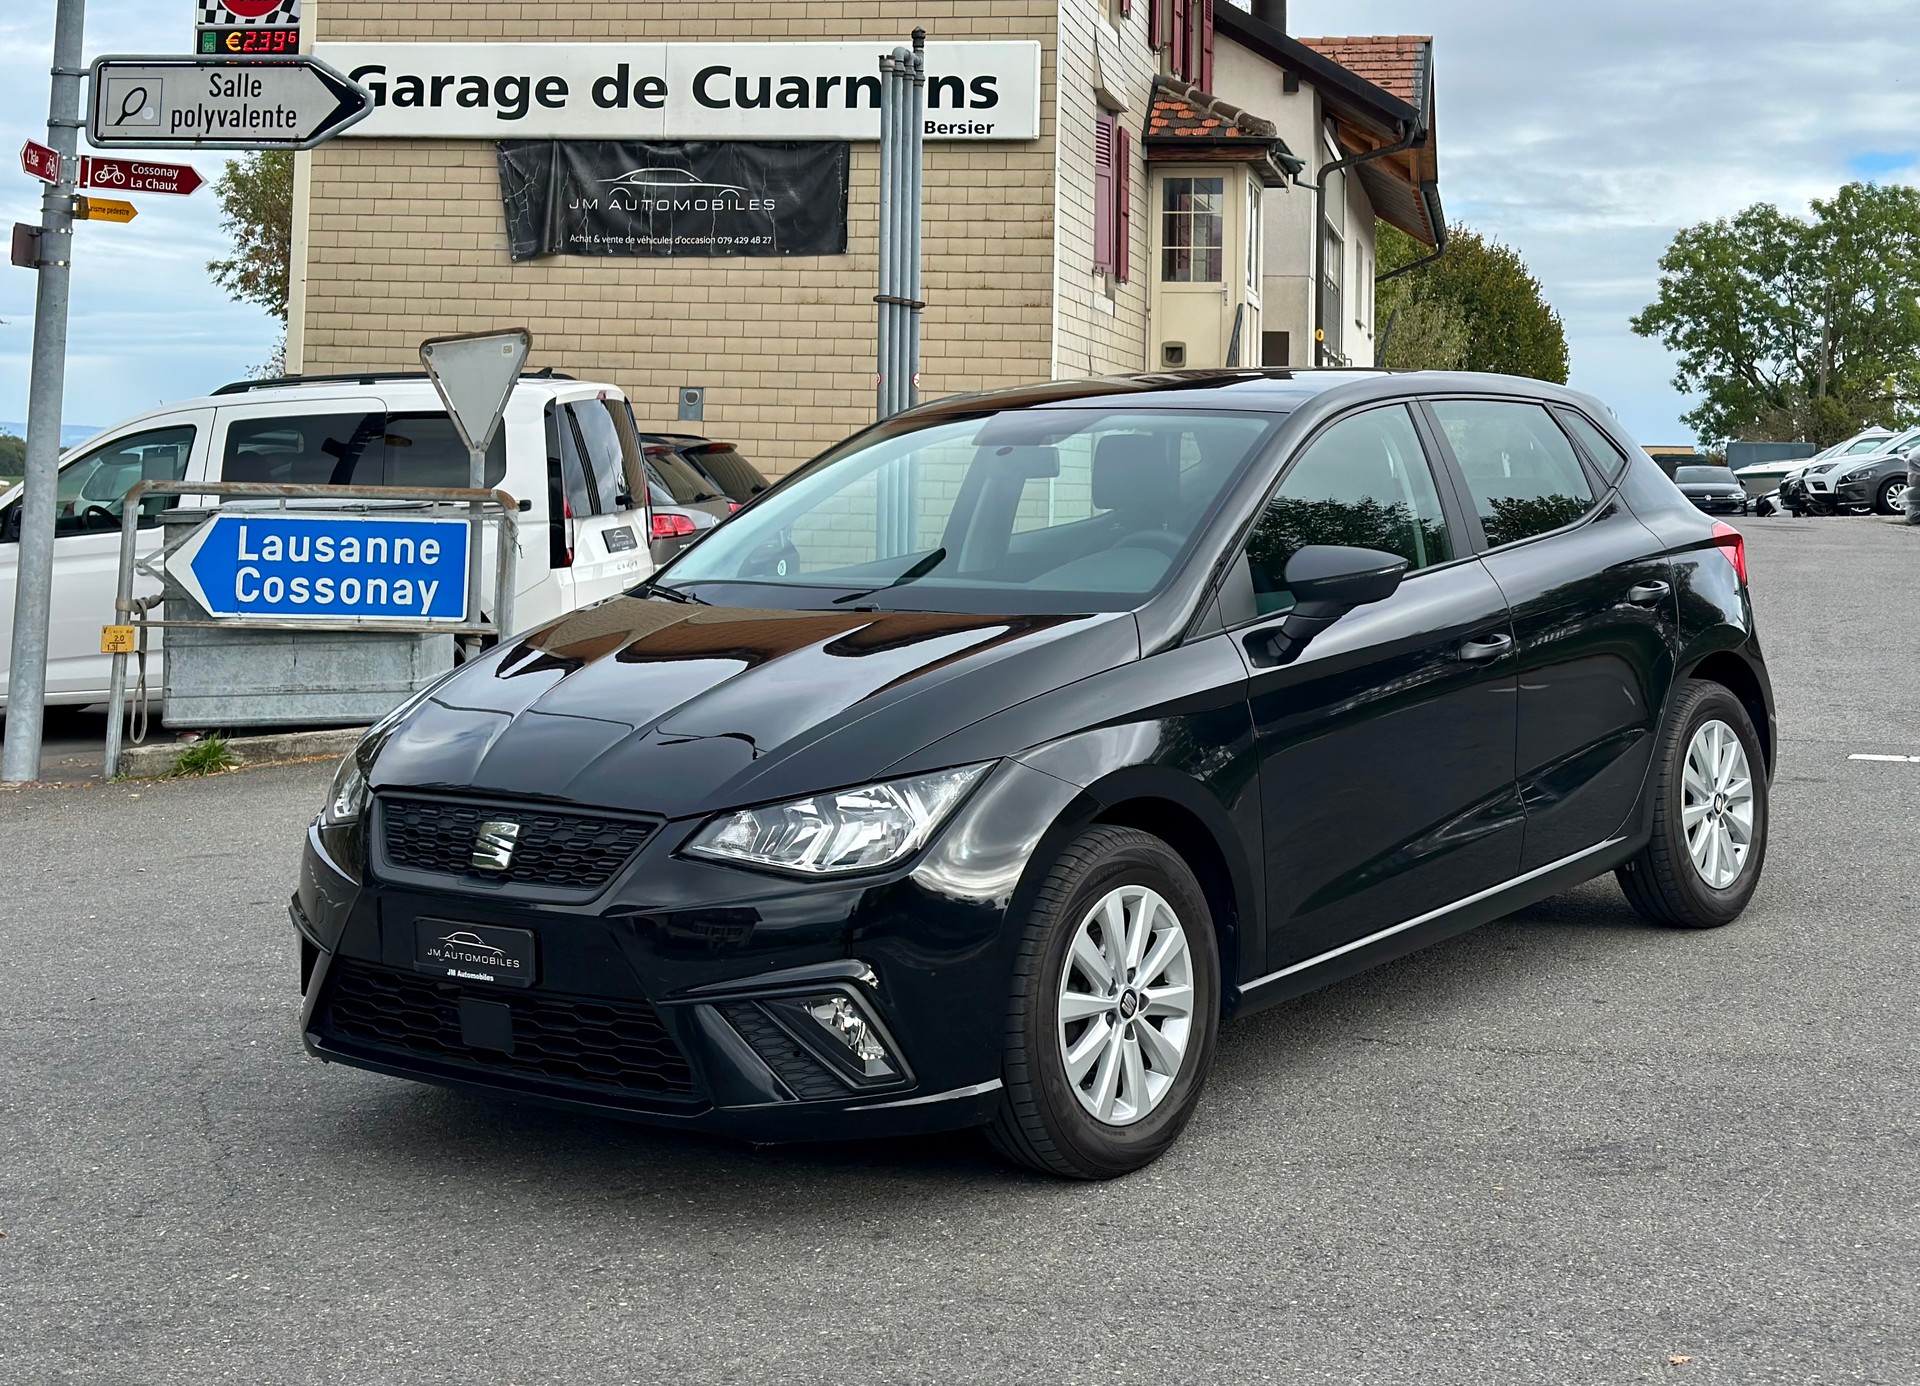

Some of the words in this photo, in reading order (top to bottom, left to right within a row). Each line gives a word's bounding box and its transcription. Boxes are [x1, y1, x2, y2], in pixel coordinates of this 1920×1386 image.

[204, 42, 214, 51] 95
[208, 72, 262, 98] Salle
[348, 64, 569, 121] Garage
[591, 63, 668, 109] de
[692, 65, 999, 109] Cuarnns
[171, 104, 297, 134] polyvalente
[924, 120, 995, 135] Bersier
[131, 163, 179, 180] Cossonay
[130, 177, 143, 188] La
[145, 179, 178, 191] Chaux
[569, 198, 598, 210] JM
[608, 199, 776, 211] AUTOMOBILES
[569, 234, 592, 243] Achat
[593, 234, 600, 243] &
[601, 235, 624, 244] vente
[625, 235, 635, 244] de
[636, 236, 673, 245] véhicules
[674, 235, 716, 245] d'occasion
[717, 236, 733, 245] 079
[733, 236, 749, 245] 429
[750, 236, 761, 245] 48
[762, 236, 772, 245] 27
[238, 525, 440, 565] Lausanne
[236, 566, 439, 614] Cossonay
[427, 949, 440, 957] JM
[444, 950, 520, 968] AUTOMOBILES
[447, 968, 456, 977] JM
[457, 969, 495, 982] Automobiles
